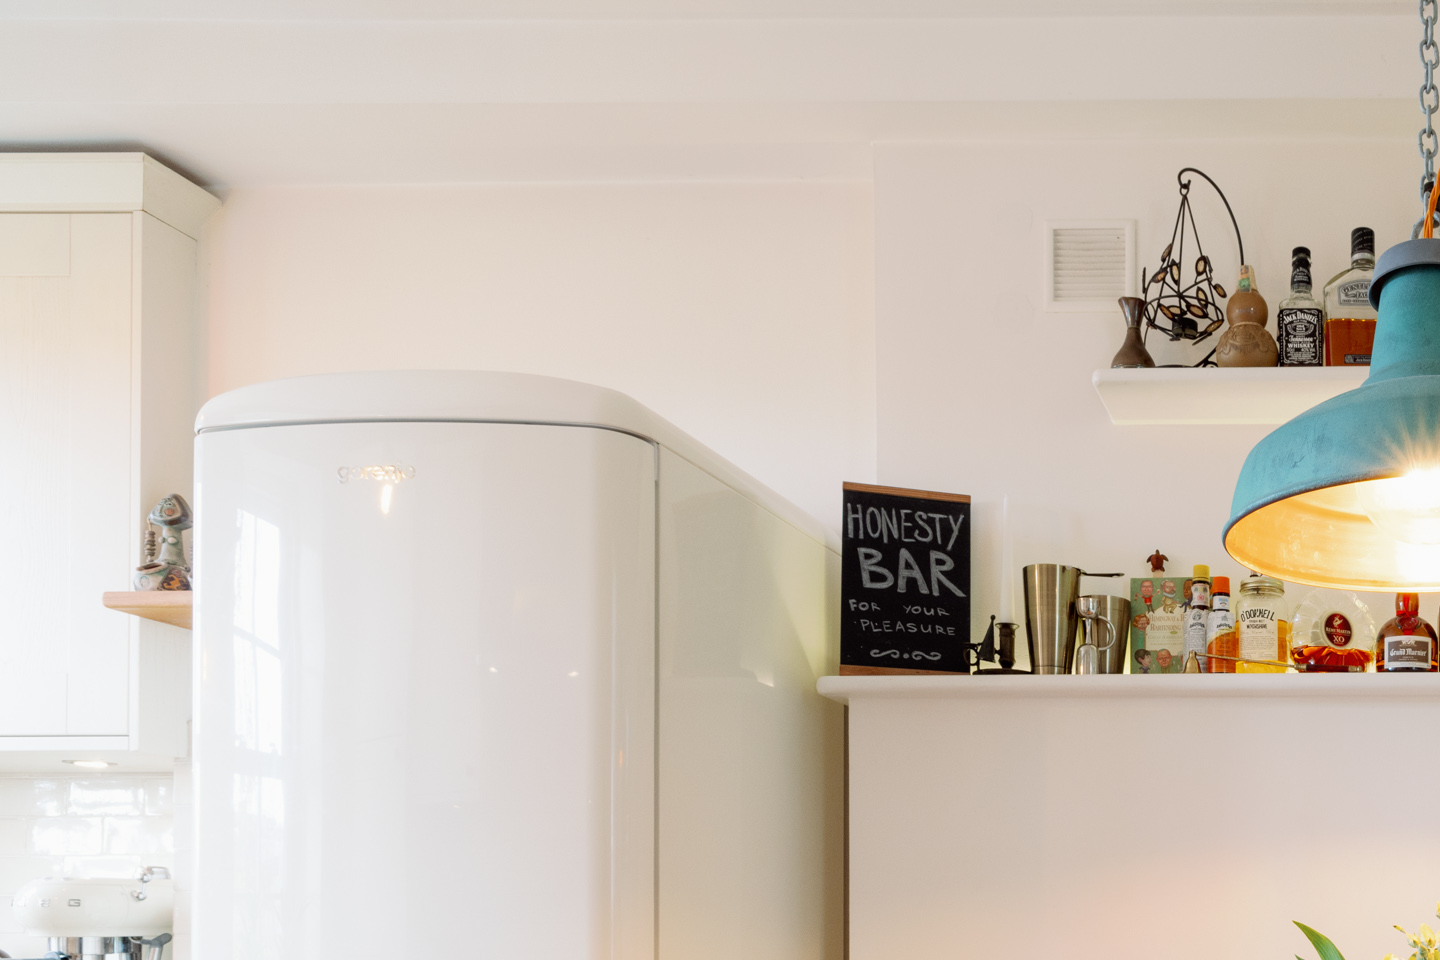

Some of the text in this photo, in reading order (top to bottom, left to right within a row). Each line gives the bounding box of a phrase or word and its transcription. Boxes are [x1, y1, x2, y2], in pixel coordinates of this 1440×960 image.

[1355, 290, 1369, 299] JAC
[1284, 314, 1297, 324] JACK
[337, 460, 416, 484] gorenje
[847, 502, 965, 551] HONESTY
[857, 547, 967, 598] BAR
[849, 599, 950, 617] FOR YOUR
[860, 619, 956, 636] PLEASURE
[1150, 623, 1181, 631] BARTENDING
[1333, 635, 1345, 643] XO
